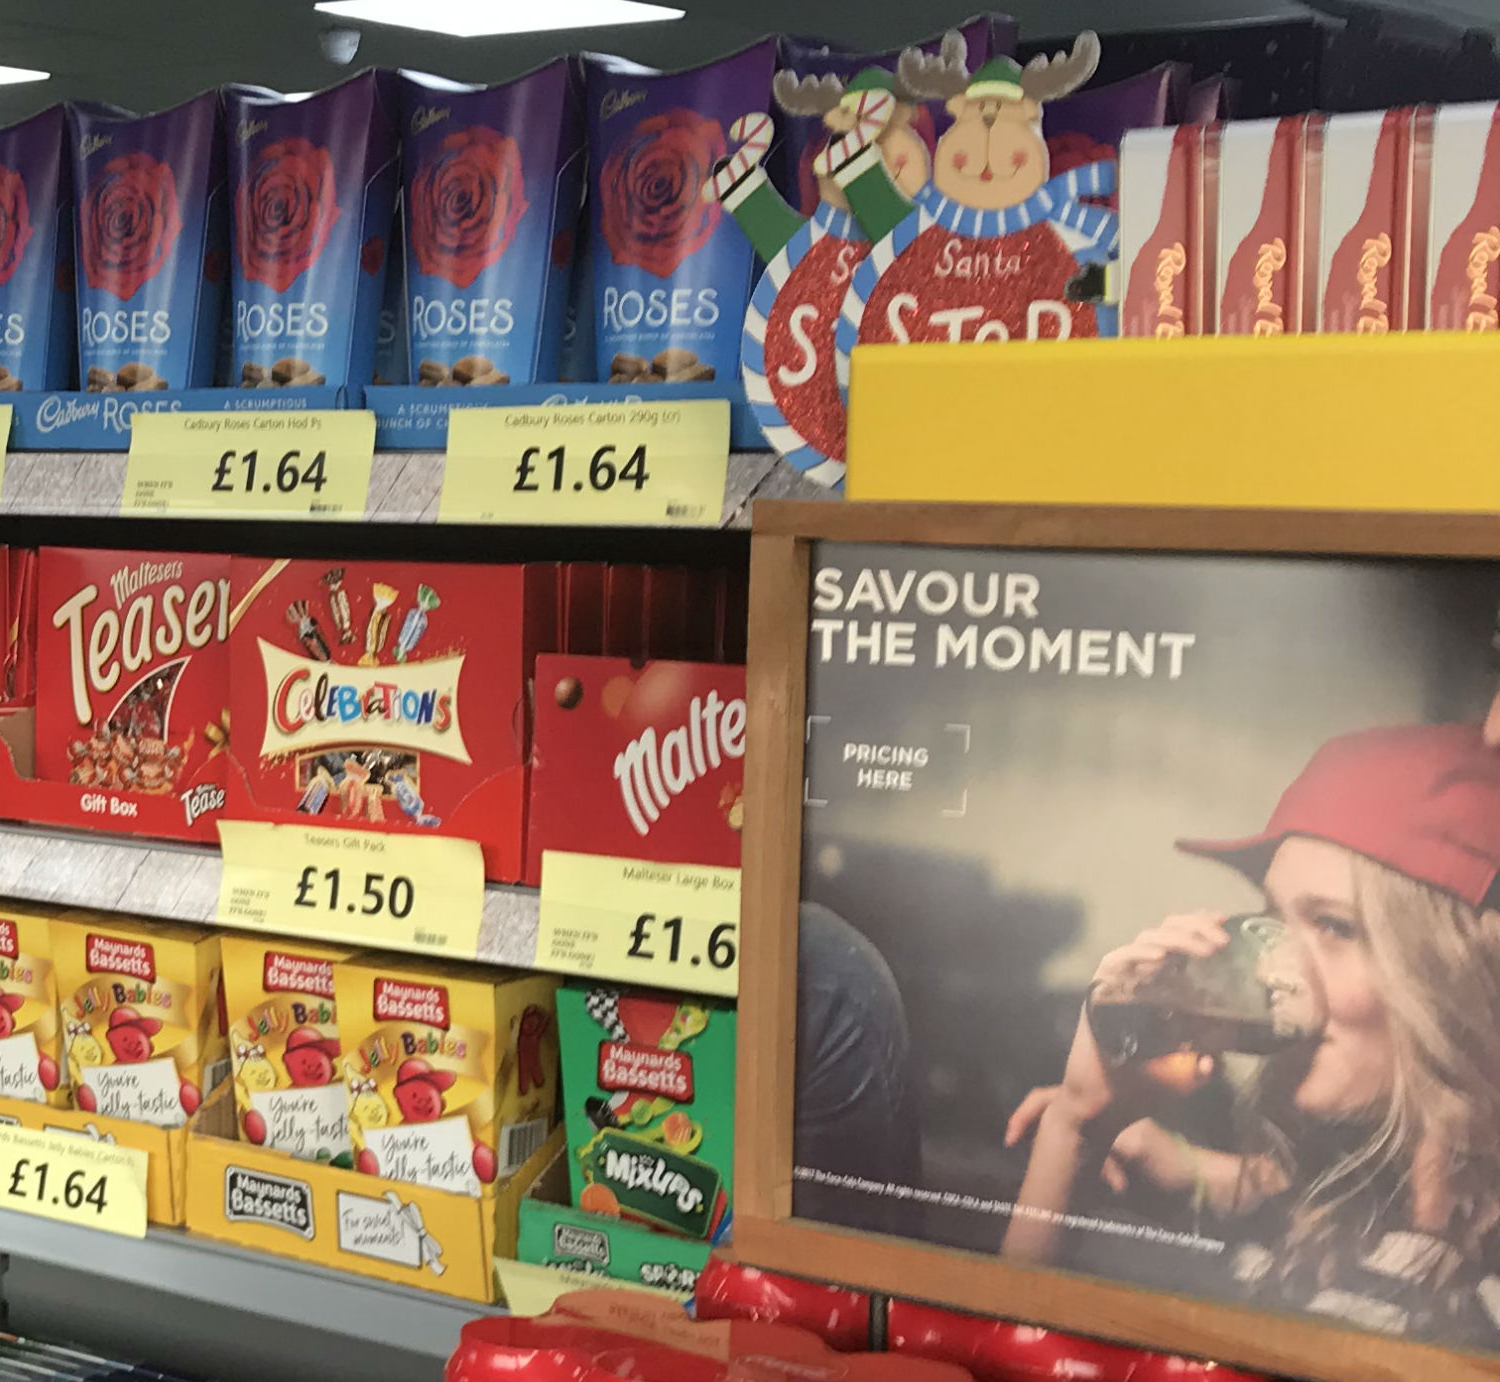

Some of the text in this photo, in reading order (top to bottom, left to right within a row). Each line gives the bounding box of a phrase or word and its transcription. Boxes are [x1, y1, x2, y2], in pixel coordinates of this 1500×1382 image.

[934, 240, 1022, 280] Santa
[82, 308, 171, 346] ROSES
[237, 300, 328, 340] ROSES
[413, 296, 514, 338] ROSES
[604, 287, 719, 330] ROSES
[36, 396, 100, 434] Cadbury
[235, 398, 307, 410] SCRUMPTIOUS
[211, 449, 328, 493] £1.64
[513, 445, 649, 492] £1.64
[110, 561, 183, 608] Maltesers
[814, 567, 1040, 619] SAVOUR
[53, 580, 230, 725] Teaser
[811, 619, 1196, 681] THE MOMENT
[843, 743, 930, 768] PRICING
[857, 767, 912, 791] HERE
[80, 793, 138, 817] Gift Box
[294, 865, 414, 920] £1.50
[623, 866, 736, 891] Malteser Large Box
[94, 935, 147, 961] Maynards
[627, 912, 737, 970] £1.6
[90, 950, 151, 979] Bassetts
[274, 953, 334, 977] Maynards
[75, 982, 172, 1020] Jelly Babies
[376, 995, 445, 1026] Bassetts
[379, 979, 441, 1004] Maynards
[248, 1003, 289, 1041] Jelly
[358, 1030, 467, 1075] Jelly Babies
[609, 1042, 684, 1073] Maynards
[98, 1070, 141, 1094] You're
[601, 1057, 688, 1095] Bassetts
[269, 1094, 318, 1121] You're
[380, 1130, 430, 1158] You're
[7, 1157, 109, 1215] £1.64
[235, 1172, 303, 1203] Maynards
[229, 1187, 308, 1228] Bassetts
